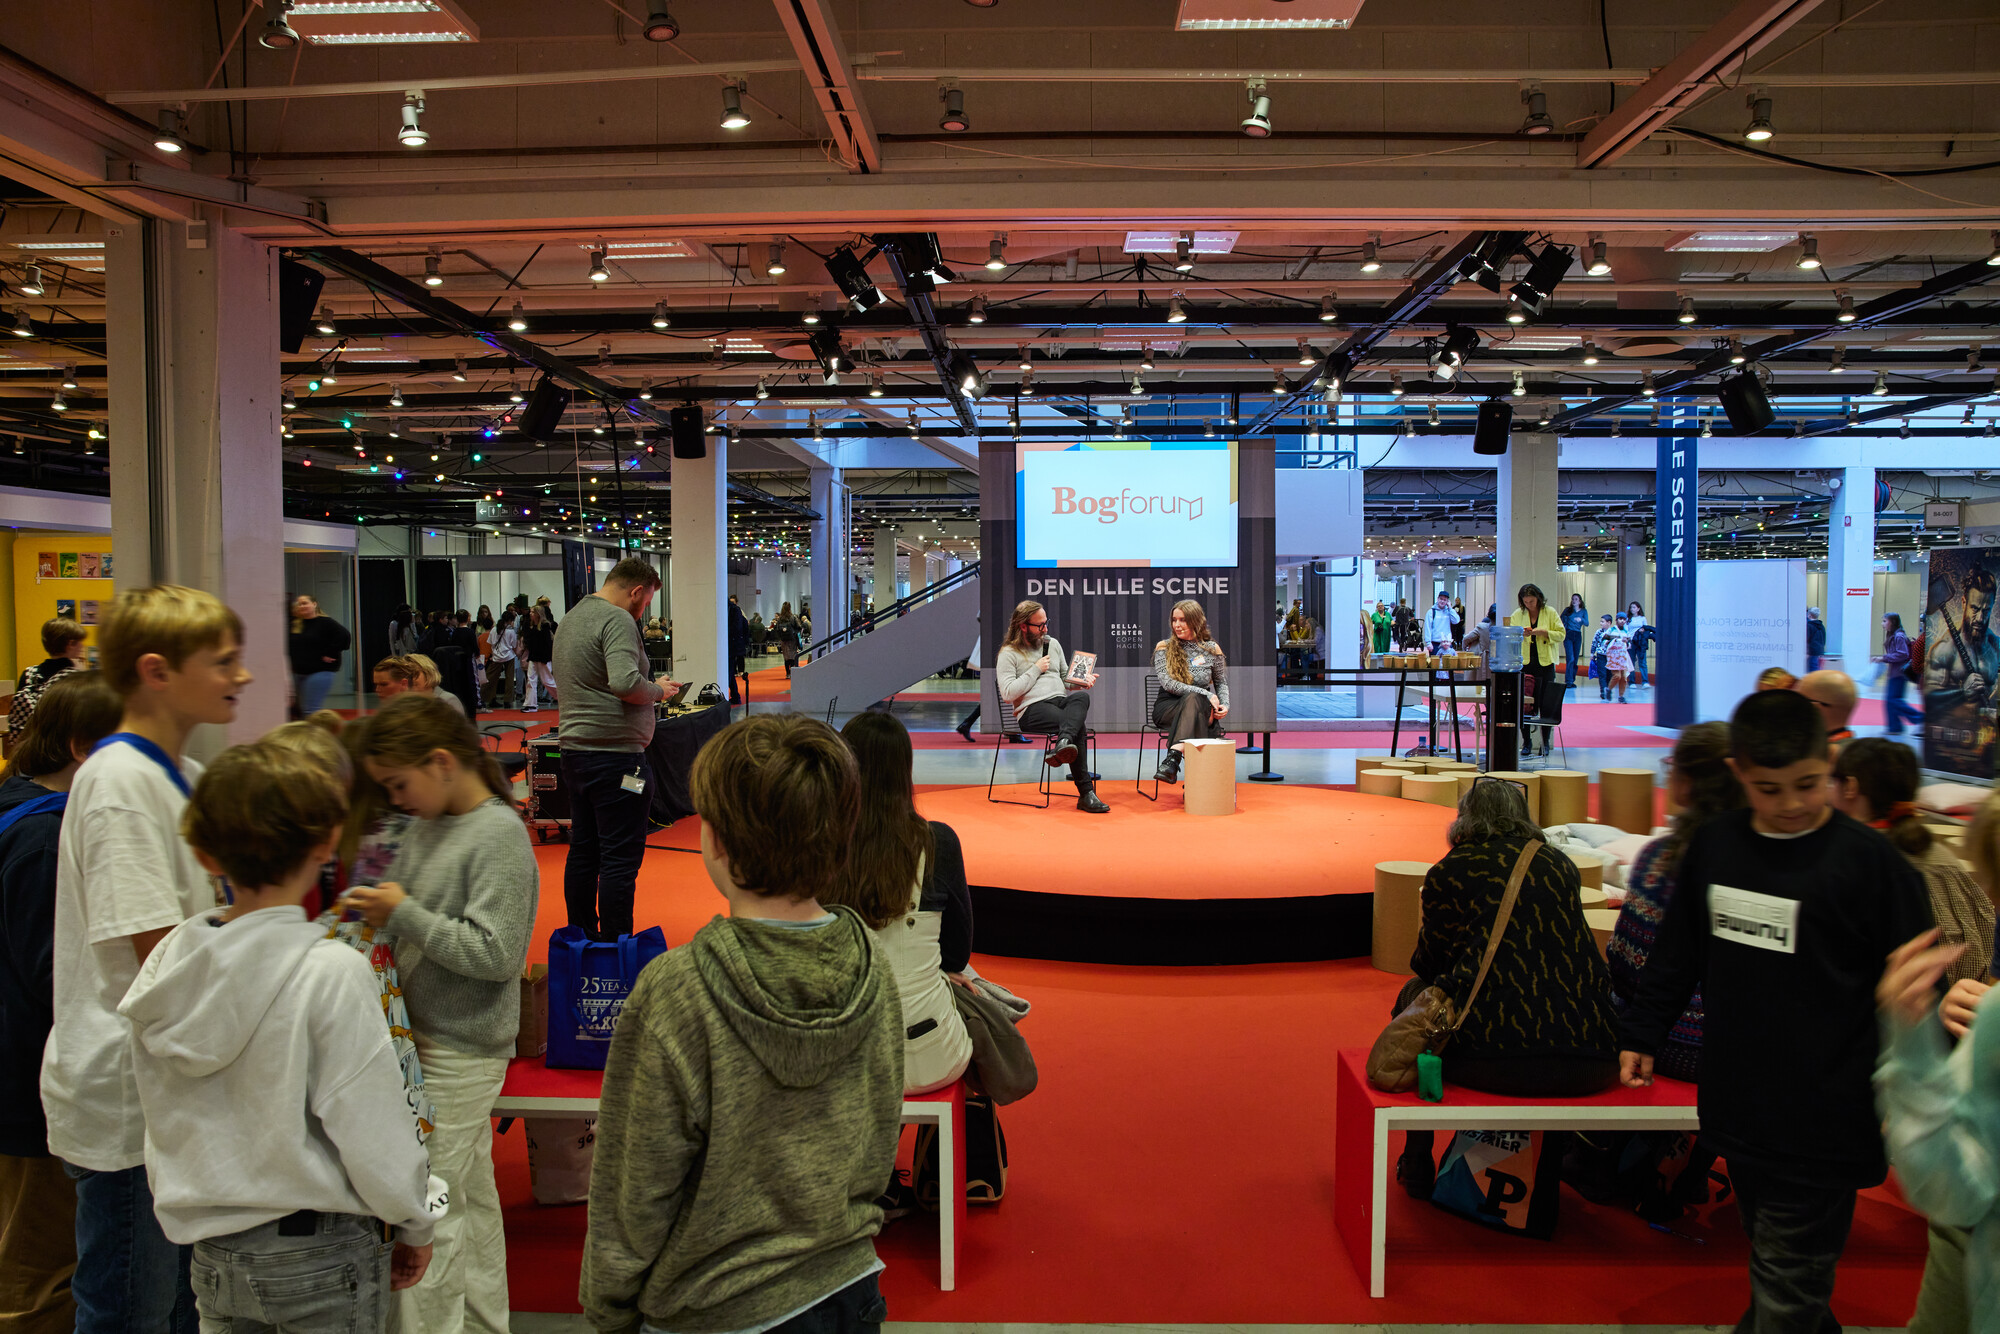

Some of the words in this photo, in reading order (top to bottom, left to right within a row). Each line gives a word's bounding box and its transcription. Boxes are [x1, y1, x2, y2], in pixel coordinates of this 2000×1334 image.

[1052, 487, 1203, 524] Bogforum
[1671, 477, 1685, 579] SCENE
[1027, 579, 1075, 596] DEN
[1083, 578, 1145, 595] LILLE
[1151, 577, 1229, 595] SCENE
[580, 976, 600, 994] 25
[1477, 1167, 1528, 1219] P
